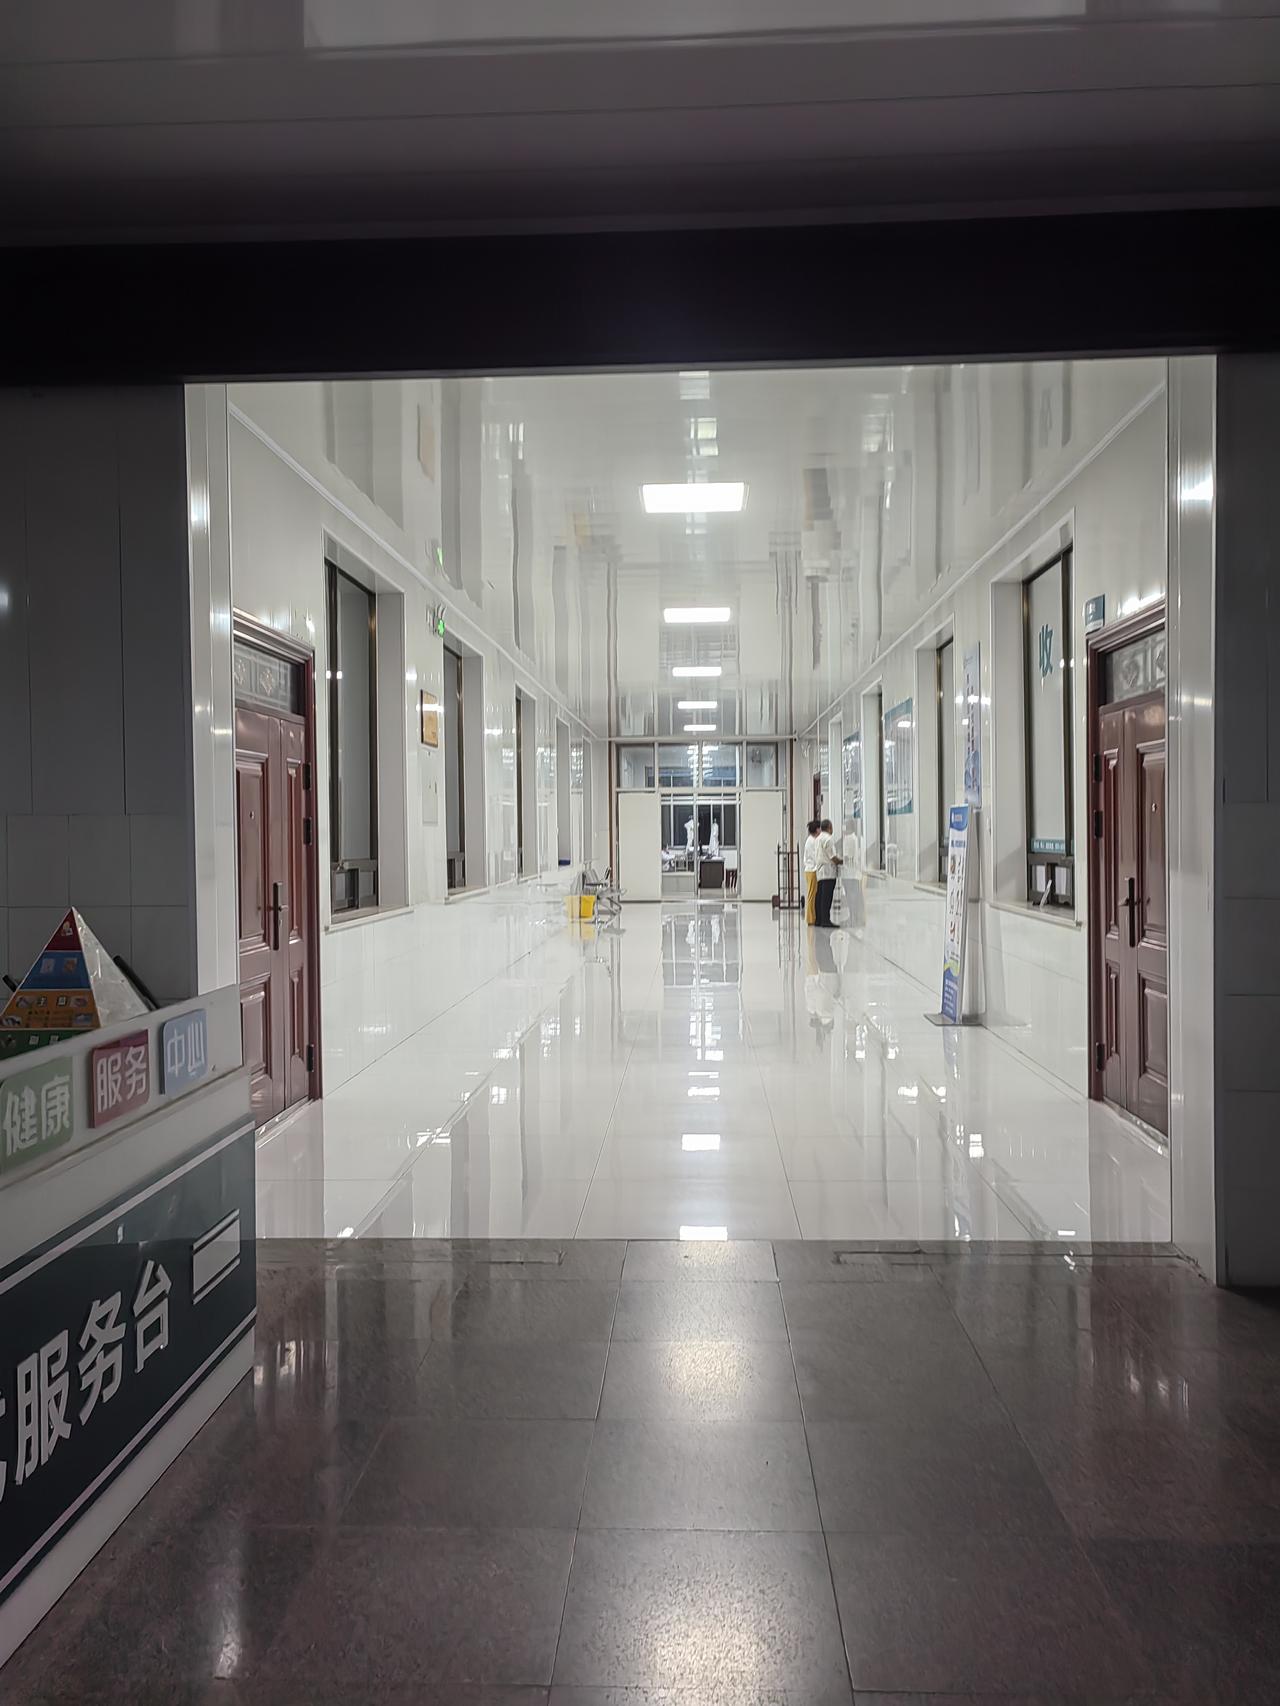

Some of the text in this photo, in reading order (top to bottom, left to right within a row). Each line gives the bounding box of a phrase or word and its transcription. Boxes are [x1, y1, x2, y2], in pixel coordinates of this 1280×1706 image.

[1039, 624, 1054, 677] 收
[0, 1260, 172, 1502] 服务台
